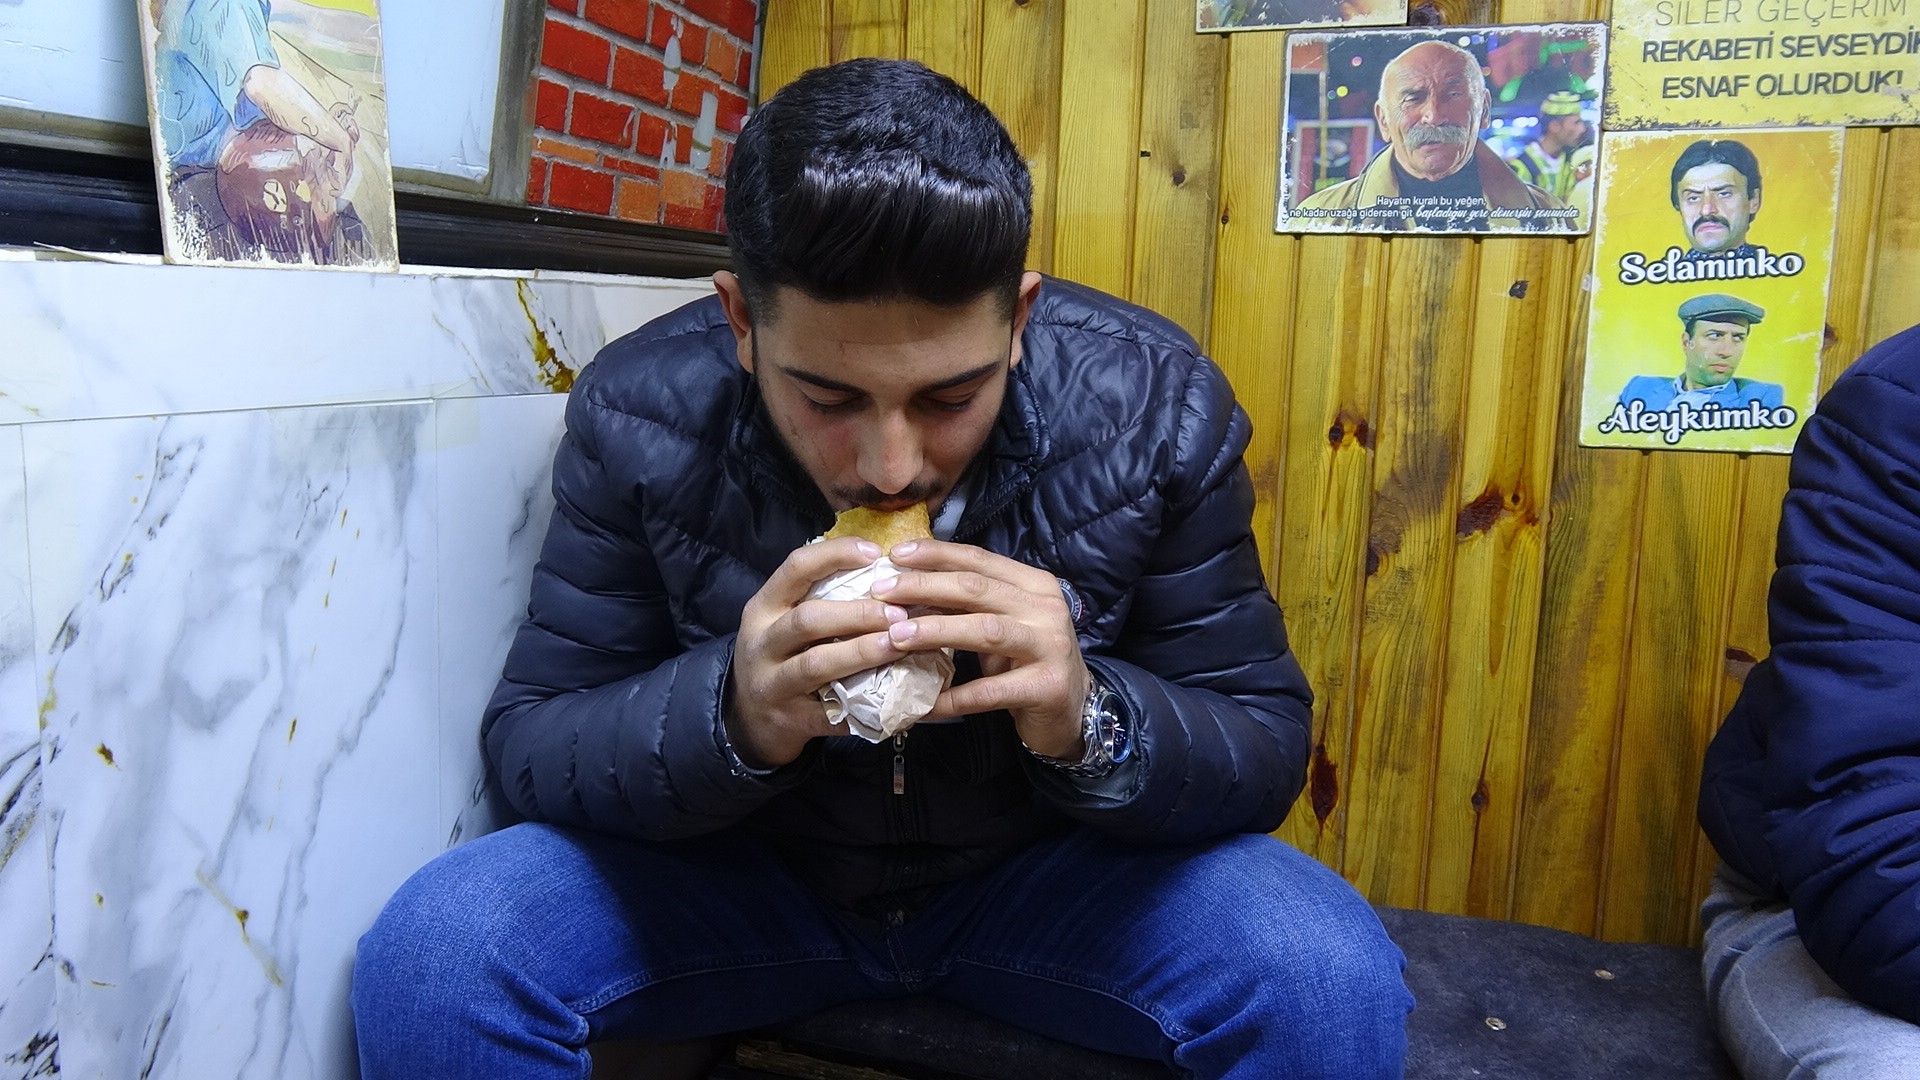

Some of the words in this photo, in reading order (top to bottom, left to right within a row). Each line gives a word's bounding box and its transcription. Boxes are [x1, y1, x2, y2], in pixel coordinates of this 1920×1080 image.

[1643, 31, 1774, 62] REKABETİ
[1662, 74, 1750, 98] ESNAF
[1756, 70, 1903, 97] OLURDUK!
[1289, 209, 1301, 217] ne
[1303, 208, 1328, 217] kadar
[1360, 208, 1399, 219] gidersen
[1401, 208, 1413, 219] git
[1469, 210, 1488, 222] yere
[1377, 196, 1411, 208] Hayatın
[1413, 196, 1438, 206] kuralı
[1440, 196, 1452, 205] bu
[1620, 246, 1804, 285] Selaminko
[1600, 399, 1798, 444] Aleykümko
